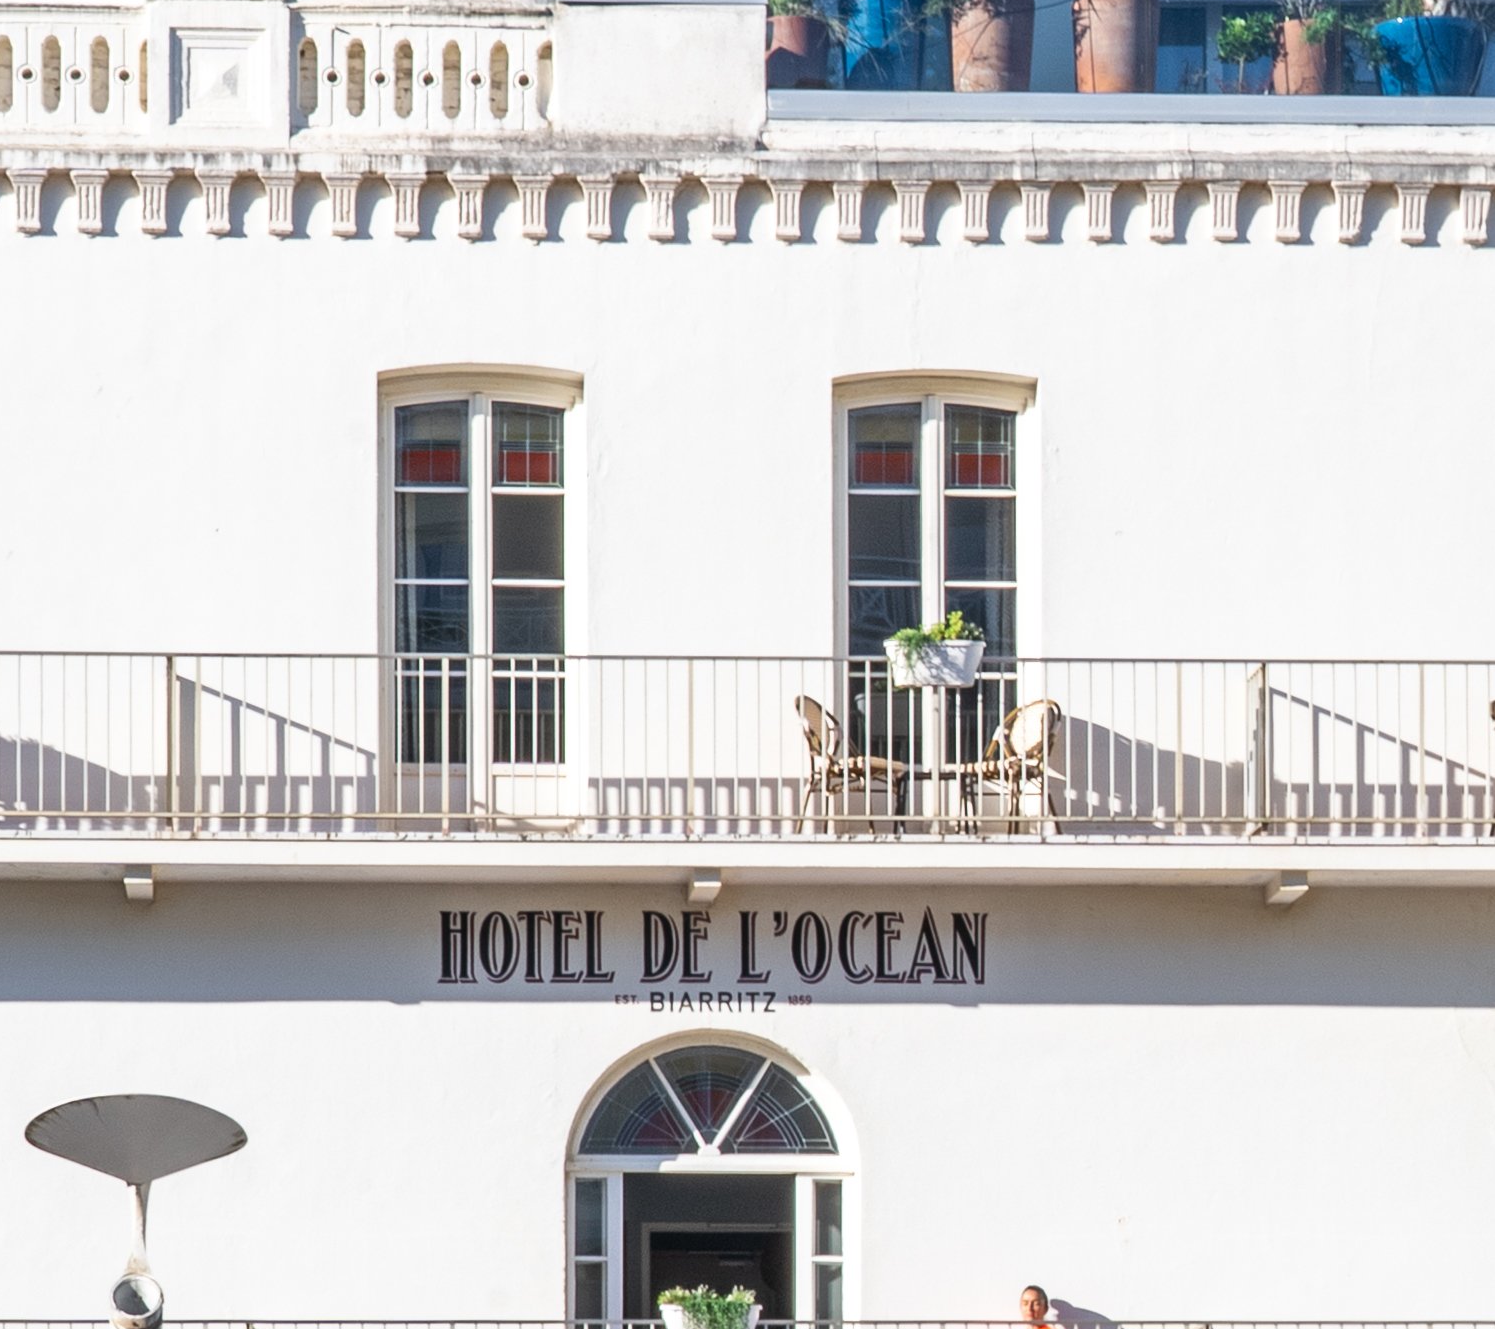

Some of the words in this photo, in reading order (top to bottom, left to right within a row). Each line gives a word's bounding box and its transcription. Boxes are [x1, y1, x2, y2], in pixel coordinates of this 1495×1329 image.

[437, 910, 615, 983] HOTEL
[640, 910, 713, 983] DE
[737, 905, 988, 984] L'OCEAN
[615, 994, 640, 1005] EST.
[650, 991, 777, 1013] BIARRITZ
[787, 994, 813, 1005] 1859
